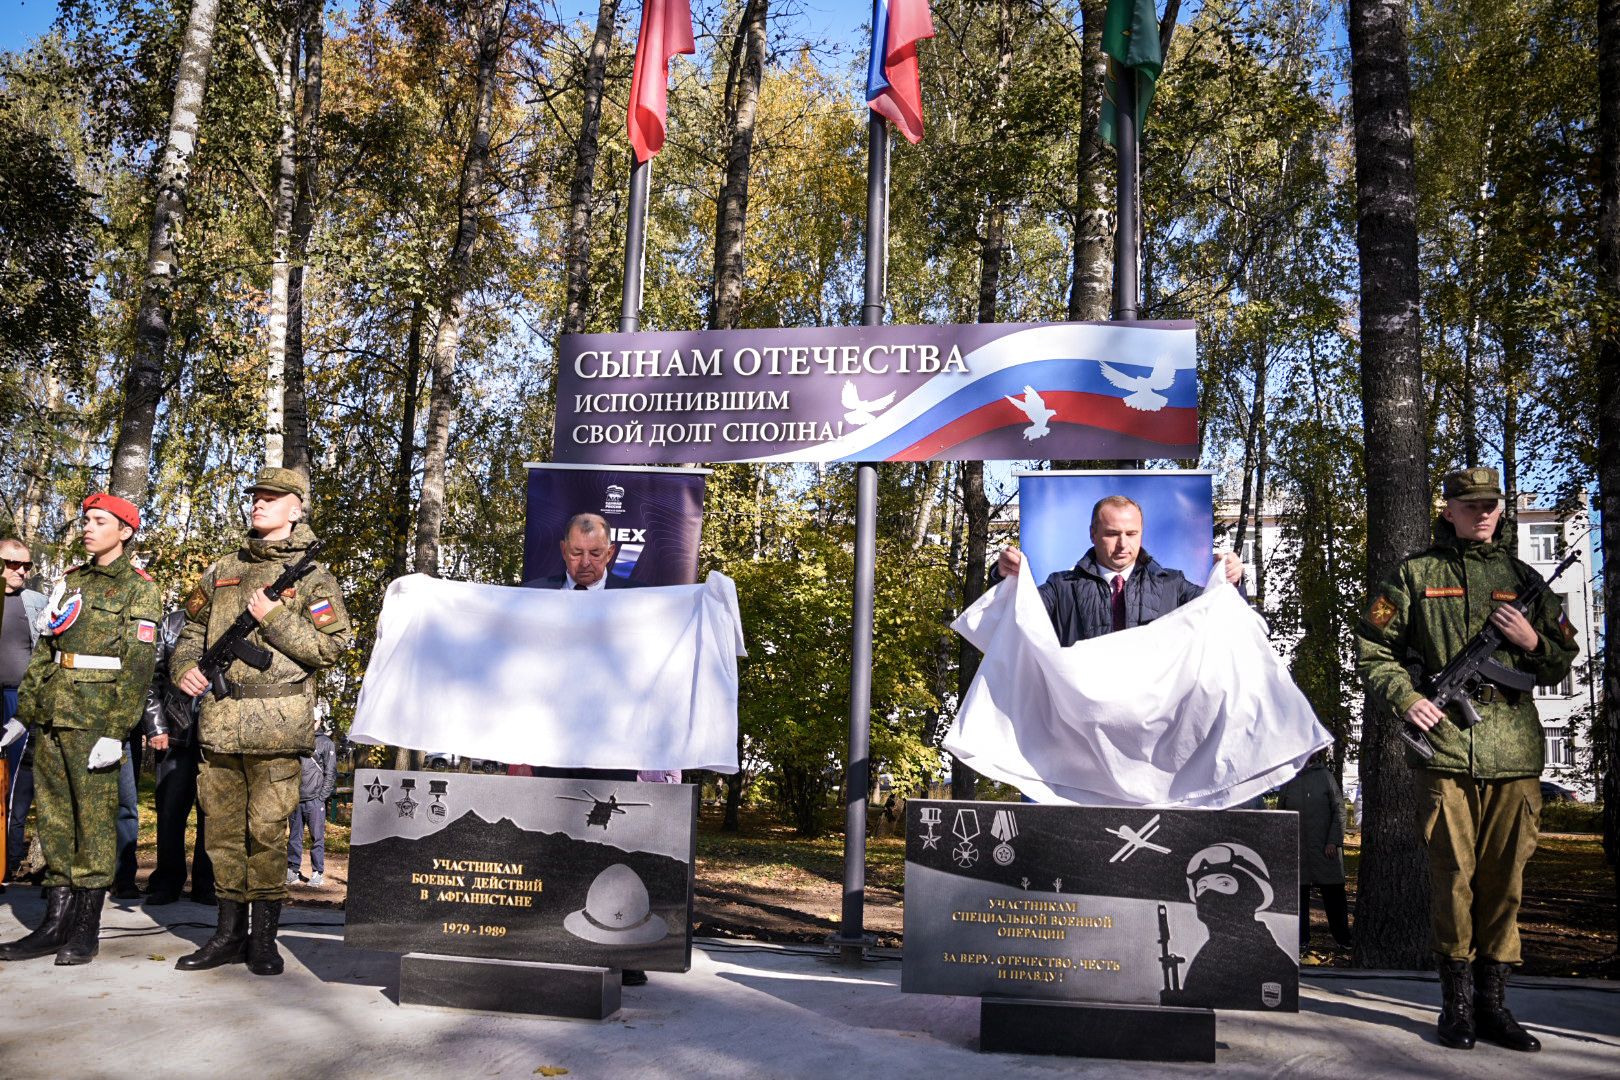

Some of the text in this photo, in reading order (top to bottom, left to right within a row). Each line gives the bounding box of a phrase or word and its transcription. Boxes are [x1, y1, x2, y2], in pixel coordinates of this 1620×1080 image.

[574, 344, 970, 379] СЫНАМ ОТЕЧЕСТВА
[573, 390, 790, 413] ИСПОЛНИВШИМ
[572, 419, 843, 447] СВОЙ ДОЛГ СПОЛНА!
[432, 858, 523, 875] УЧАСТНИКАМ
[411, 872, 543, 892] БОЕВЫХ ДЕЙСТВИЙ
[420, 889, 533, 907] В АФГАНИСТАНЕ
[988, 898, 1078, 913] УЧАСТНИКАМ
[952, 911, 1113, 928] СПЕЦИАЛЬНОЙ ВОЕННОЙ
[997, 927, 1066, 940] ОПЕРАЦИИ
[943, 952, 956, 963] ЗА
[1080, 959, 1120, 971] ЧЕСТЬ
[998, 969, 1006, 979] И
